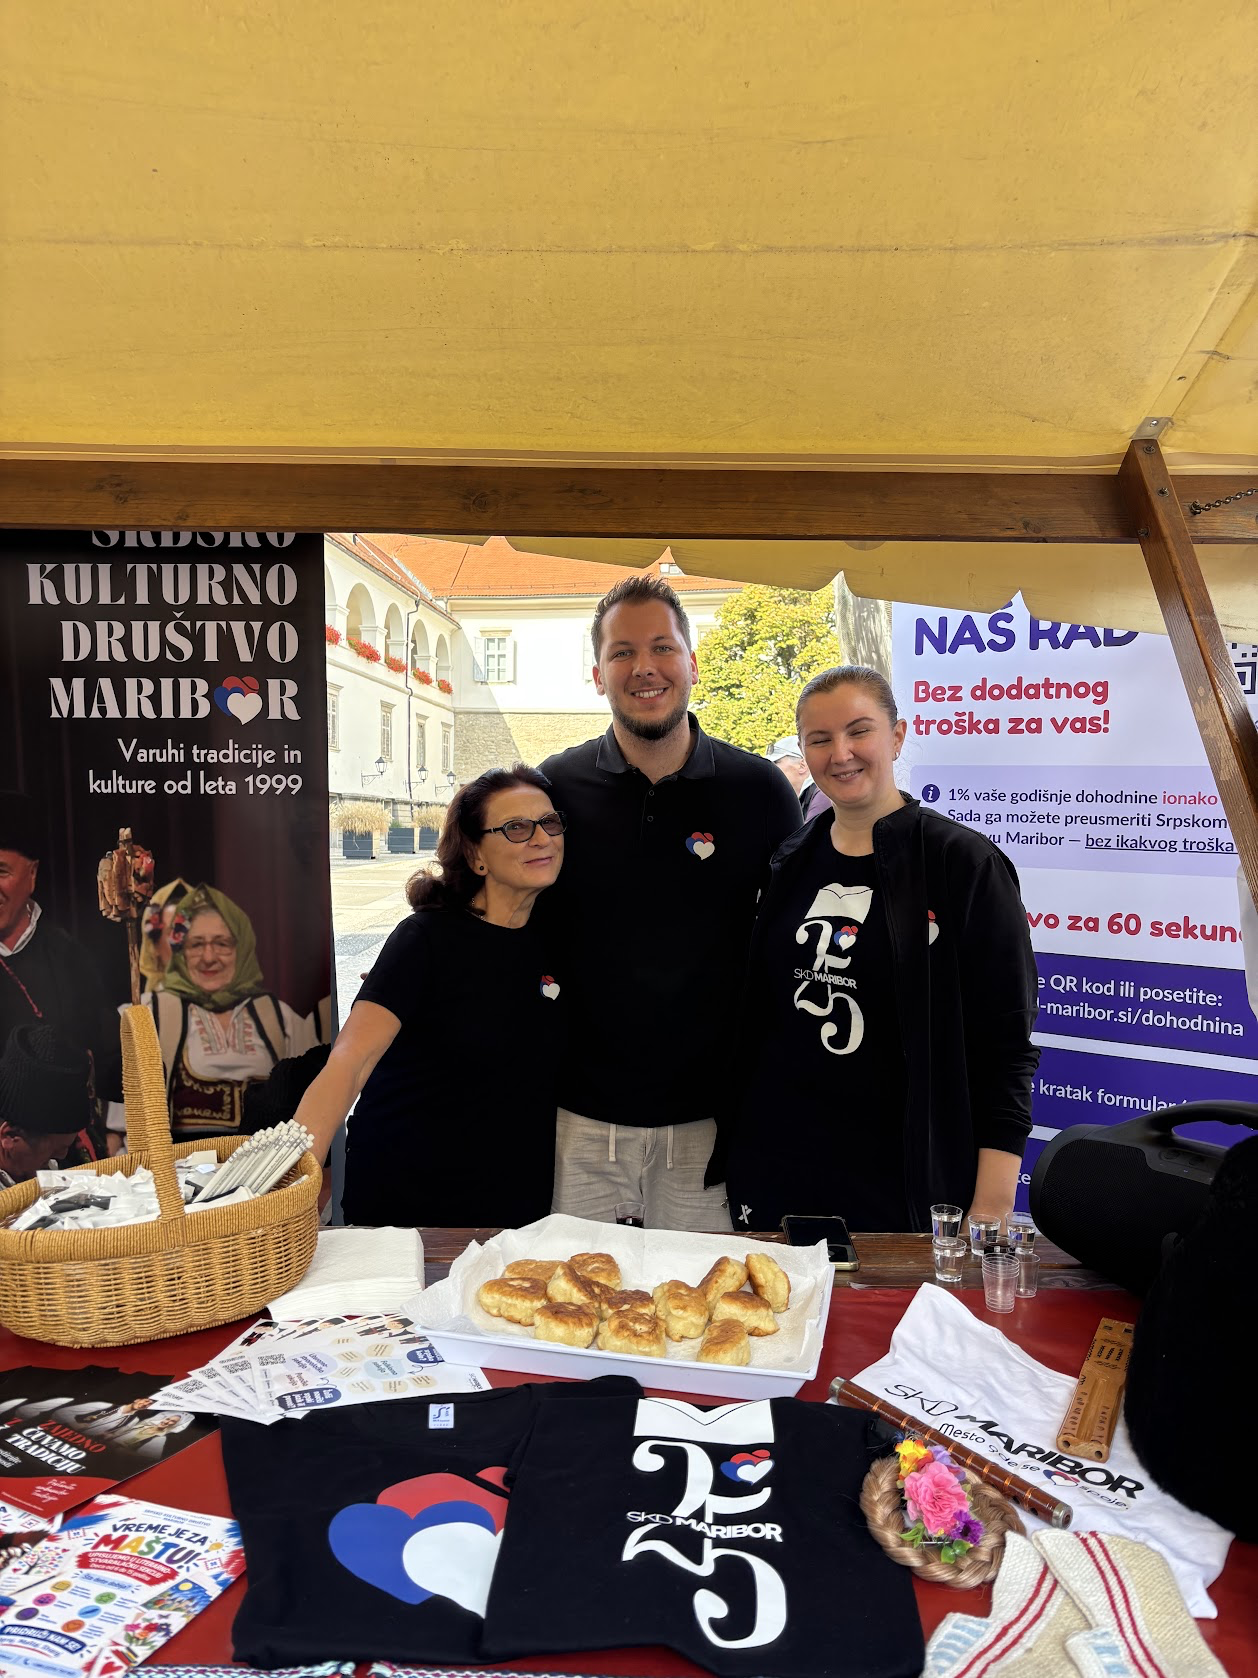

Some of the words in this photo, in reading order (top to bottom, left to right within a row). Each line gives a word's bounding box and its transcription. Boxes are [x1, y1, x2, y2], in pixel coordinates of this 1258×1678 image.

[26, 563, 298, 606] KULTURNO
[60, 611, 299, 663] DRUŠTVO
[914, 600, 1016, 655] NAŠ
[913, 680, 963, 703] Bez
[970, 676, 1109, 705] dodatnog
[913, 711, 1000, 735] troška
[1007, 716, 1043, 735] za
[1050, 709, 1110, 734] vas!
[117, 738, 184, 763] Varuhi
[192, 739, 276, 768] tradicije
[284, 744, 302, 764] in
[88, 769, 157, 794] kulture
[163, 770, 192, 794] od
[199, 770, 237, 794] leta
[244, 773, 303, 795] 1999
[948, 788, 970, 801] 1%
[974, 788, 1007, 802] vaše
[1010, 789, 1072, 805] godišnje
[1075, 789, 1158, 804] dohodnine
[1162, 791, 1218, 805] ionako
[947, 809, 981, 822] Sada
[985, 812, 1002, 825] ga
[1006, 810, 1061, 824] možete
[1064, 812, 1152, 827] preusmeriti
[1155, 813, 1228, 830] Srpskom
[1005, 831, 1065, 846] Maribor
[1085, 833, 1112, 848] bez
[1116, 834, 1178, 853] ikakvog
[1182, 837, 1234, 852] troška
[1066, 915, 1100, 932] za
[1107, 912, 1142, 936] 60
[1149, 915, 1243, 943] sekun
[793, 968, 814, 981] SKD
[813, 971, 858, 989] MARIBOR
[1049, 974, 1077, 993] QR
[1082, 977, 1115, 996] kod
[1119, 981, 1135, 998] ili
[1139, 986, 1223, 1007] posetite:
[1039, 1078, 1093, 1102] kratak
[22, 1426, 87, 1460] ČUVAMO
[38, 1419, 107, 1453] ZAJEDNO
[884, 1384, 959, 1417] SKD
[954, 1414, 1145, 1500] MARIBOR
[939, 1422, 986, 1444] Mesto
[1022, 1463, 1041, 1472] se
[5, 1433, 87, 1474] TRADICIJU
[111, 1522, 171, 1535] VREME
[168, 1527, 187, 1539] JE
[184, 1532, 209, 1546] ZA
[626, 1511, 673, 1525] SKD
[675, 1517, 783, 1542] MARIBOR
[88, 1552, 131, 1562] UPISUJEMO
[91, 1533, 202, 1570] MAŠTU!
